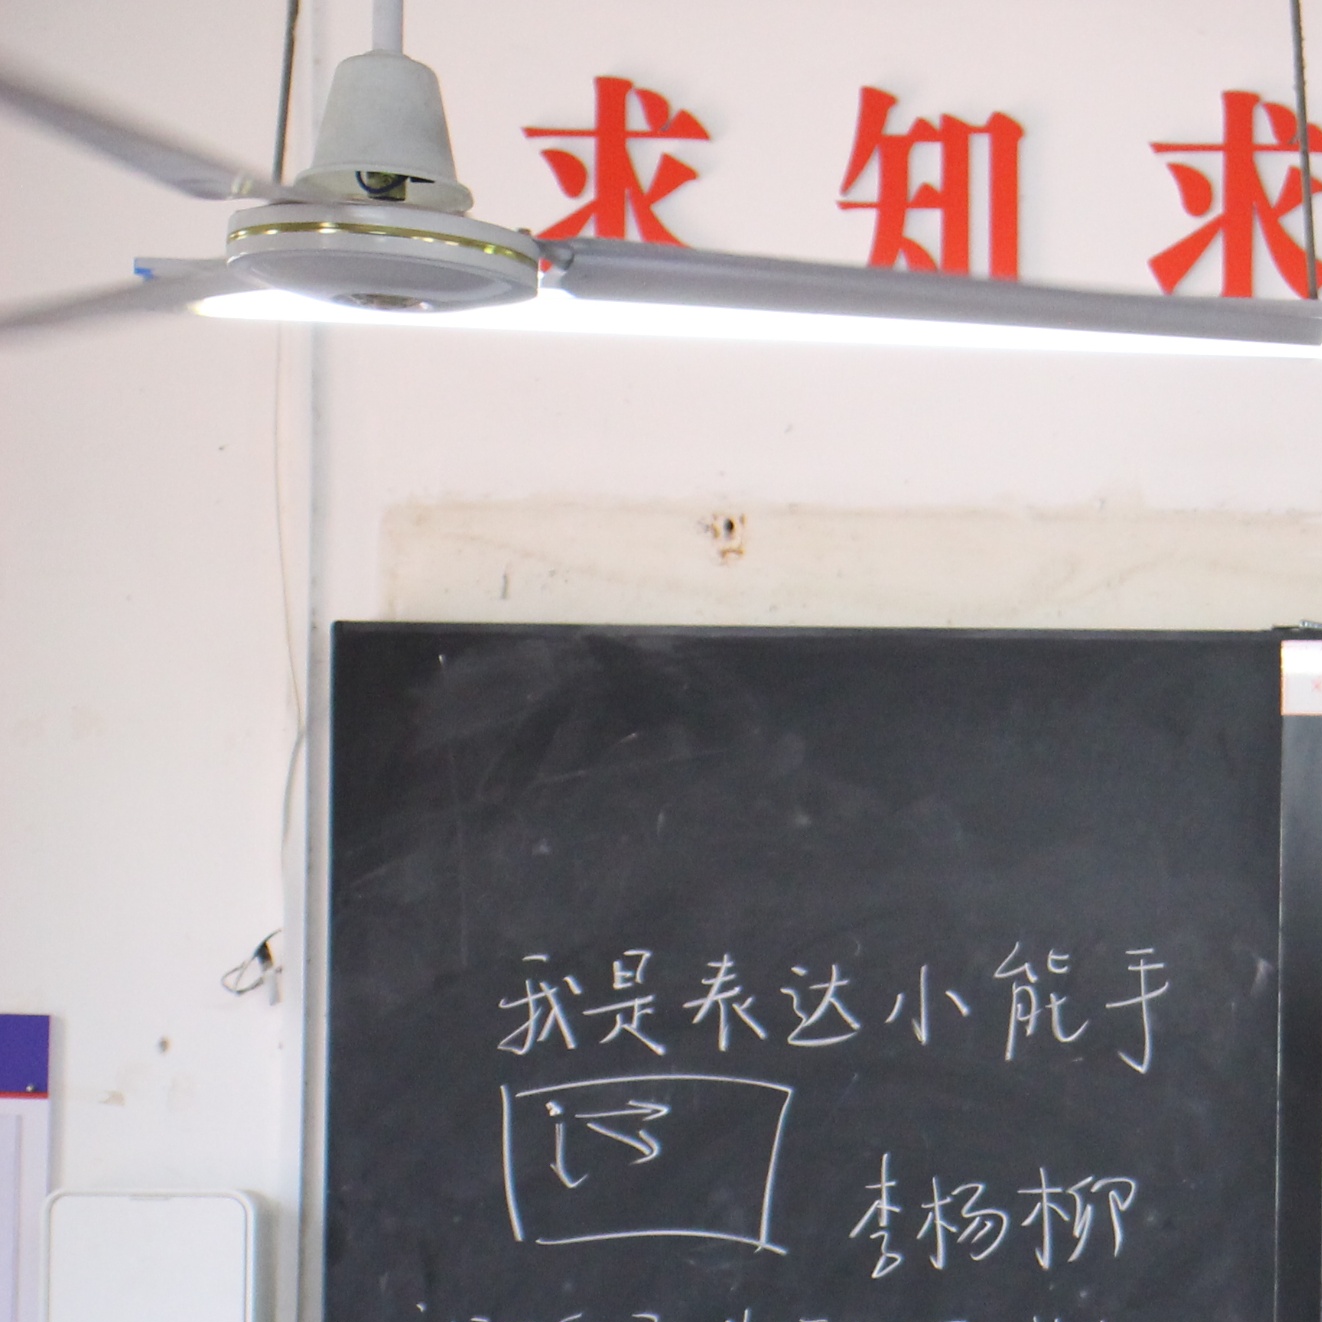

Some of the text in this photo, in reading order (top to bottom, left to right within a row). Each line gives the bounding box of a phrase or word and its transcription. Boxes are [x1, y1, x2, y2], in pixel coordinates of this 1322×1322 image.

[497, 943, 1170, 1072] 我是表达小能手
[850, 1152, 1137, 1278] 李杨柳
